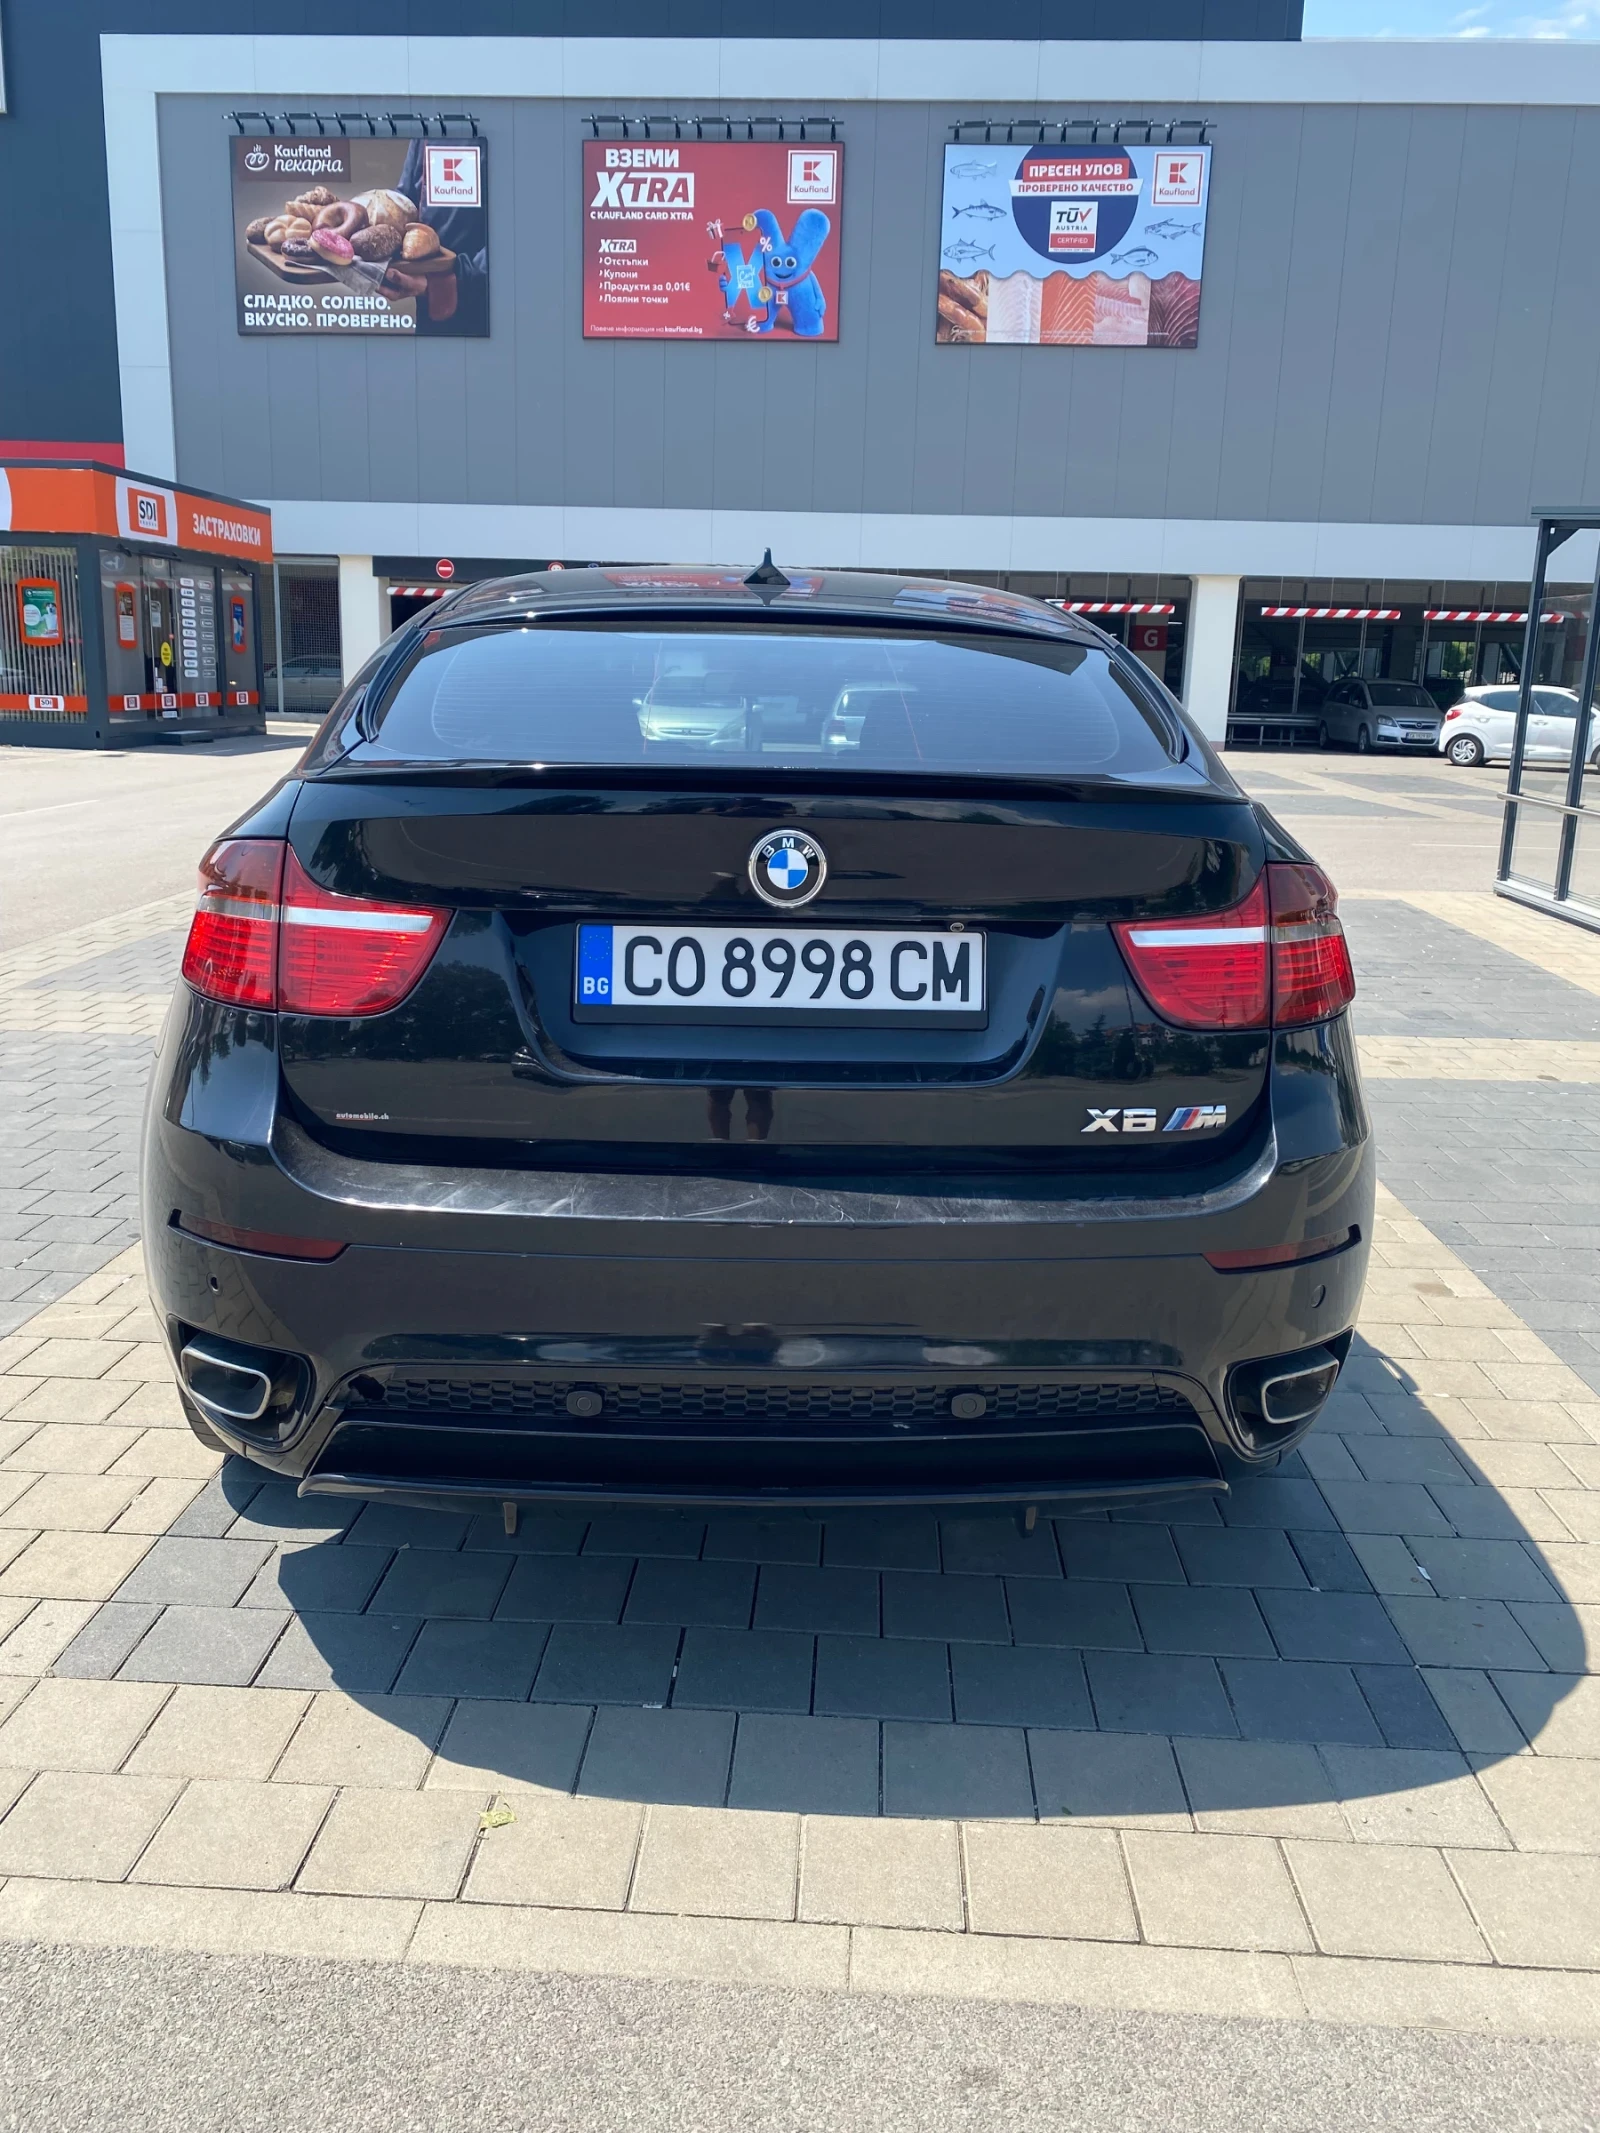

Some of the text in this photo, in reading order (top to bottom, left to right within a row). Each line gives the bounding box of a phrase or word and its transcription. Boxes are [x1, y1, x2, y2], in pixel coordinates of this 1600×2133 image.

[274, 144, 332, 158] Kaufland
[605, 148, 679, 168] ВЗЕМИ
[274, 158, 344, 176] пекарна
[1029, 163, 1123, 178] ПРЕСЕН УЛОВ
[434, 186, 473, 195] Kaufland
[590, 171, 695, 208] XTRA
[794, 185, 829, 193] Kaufland
[1018, 183, 1134, 193] ПРОВЕРЕНО КАЧЕСТВО
[1159, 187, 1196, 196] Kaufland
[597, 211, 643, 220] KAUFLAND
[645, 212, 668, 220] CARD
[670, 212, 694, 221] XTRA
[598, 238, 637, 253] XTRA
[603, 256, 649, 266] Отстъпки
[603, 269, 638, 280] Купони
[603, 281, 651, 293] Продукти
[243, 294, 391, 311] СЛАДКО. СОЛЕНО.
[641, 296, 669, 304] точки
[244, 312, 417, 328] ВКУСНО. ПРОВЕРЕНО.
[139, 500, 157, 522] SDI
[192, 513, 261, 546] ЗАСТРАХОВКИ
[1144, 629, 1158, 647] G
[762, 837, 815, 859] BMW
[721, 937, 874, 1000] 8998
[890, 940, 970, 1002] CM
[582, 976, 609, 995] BG
[335, 1112, 389, 1120] automobile.ch
[1080, 1108, 1157, 1132] X6
